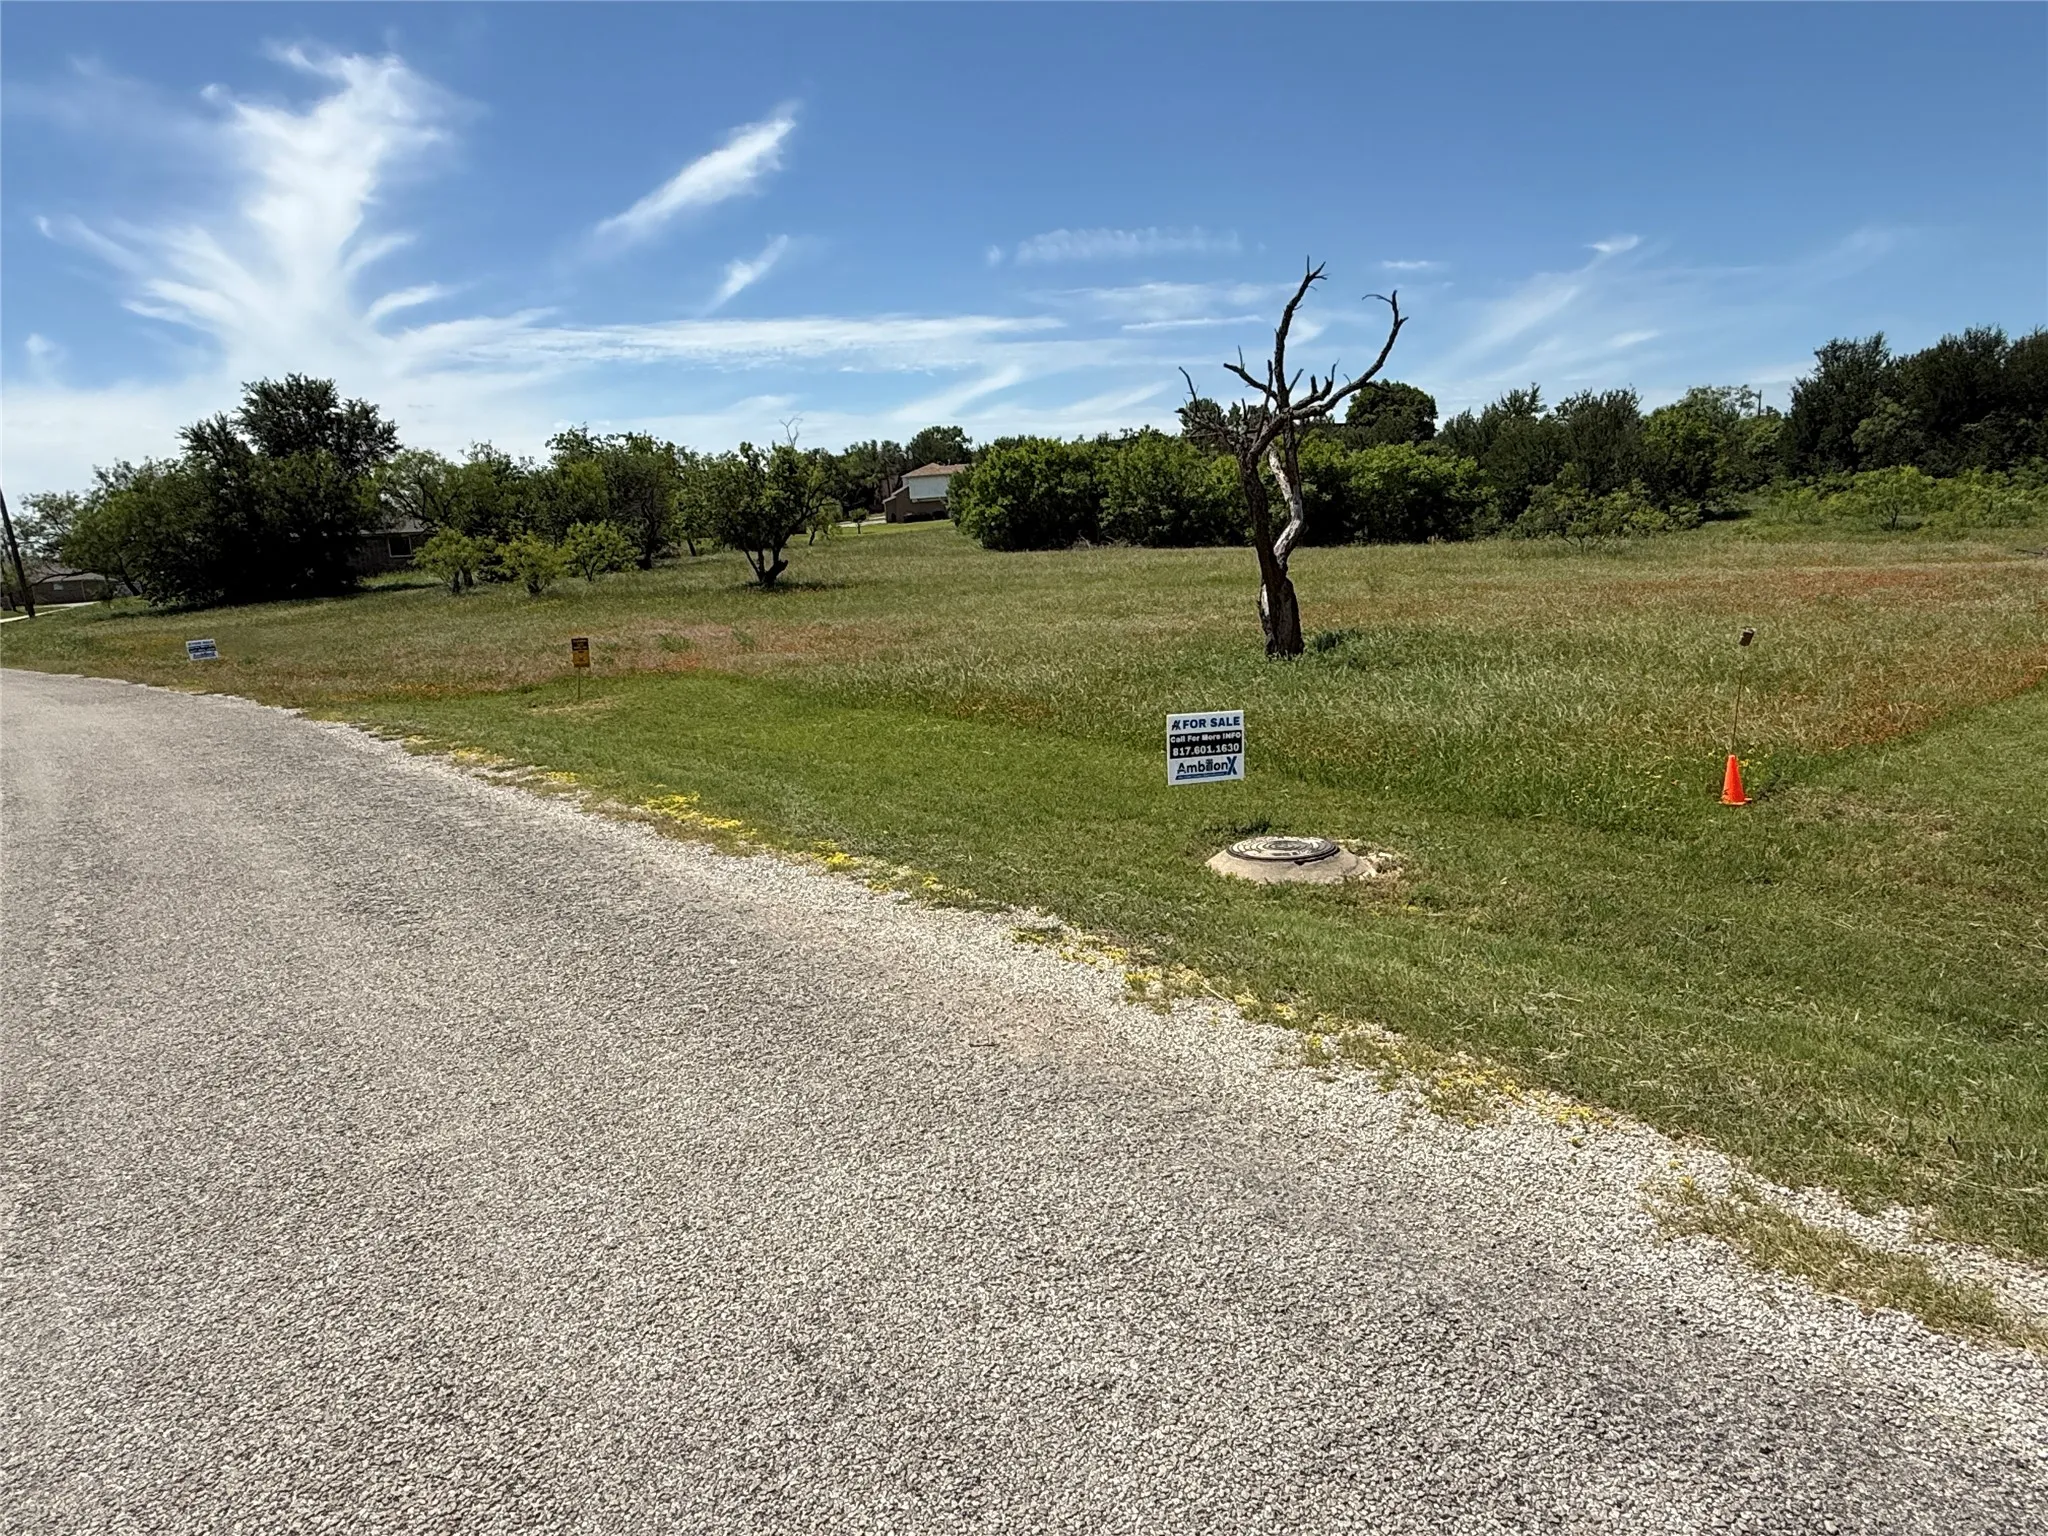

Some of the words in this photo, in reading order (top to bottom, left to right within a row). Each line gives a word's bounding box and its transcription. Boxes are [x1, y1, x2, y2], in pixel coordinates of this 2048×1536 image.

[1183, 719, 1206, 730] FOR
[1210, 716, 1240, 727] SALE
[1173, 743, 1239, 756] 817.601.1630
